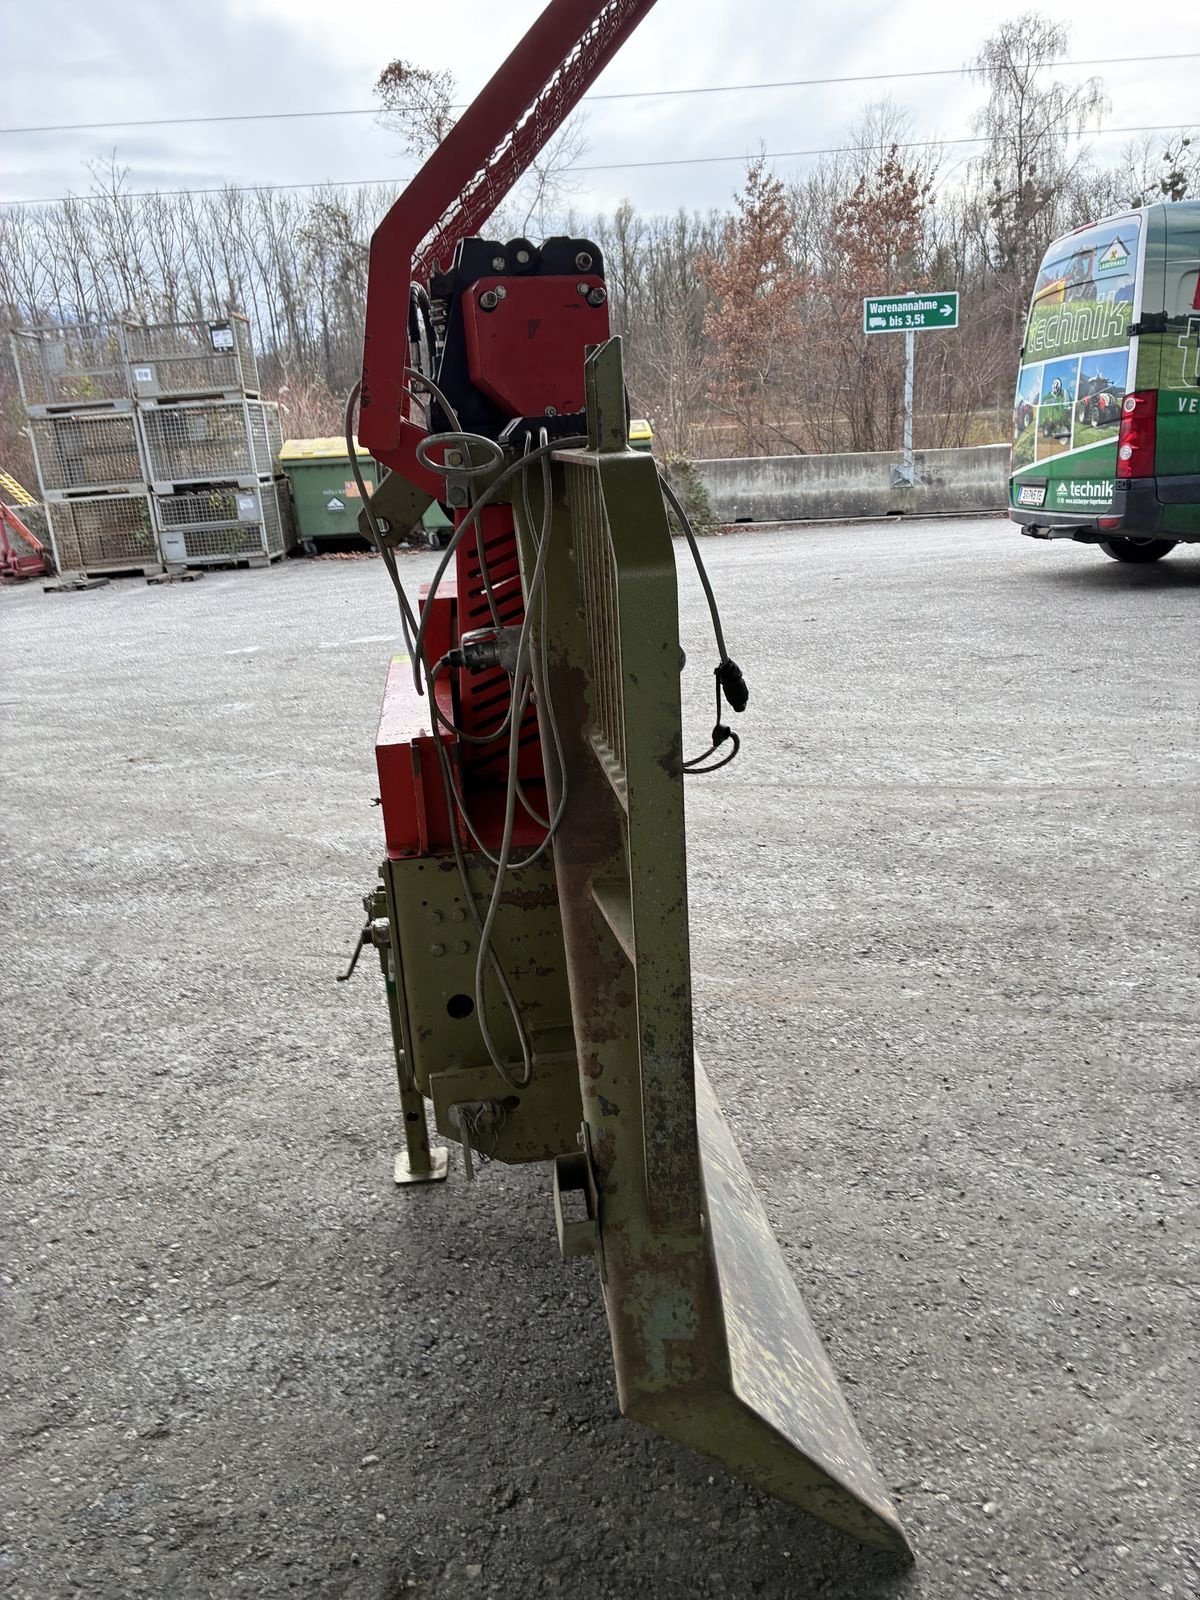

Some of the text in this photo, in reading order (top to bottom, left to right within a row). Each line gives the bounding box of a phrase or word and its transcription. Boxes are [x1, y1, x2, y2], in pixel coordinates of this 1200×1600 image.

[869, 300, 938, 314] Warenannahme
[889, 314, 925, 327] bis 3,5t
[1027, 290, 1128, 353] technik
[1070, 480, 1114, 497] technik
